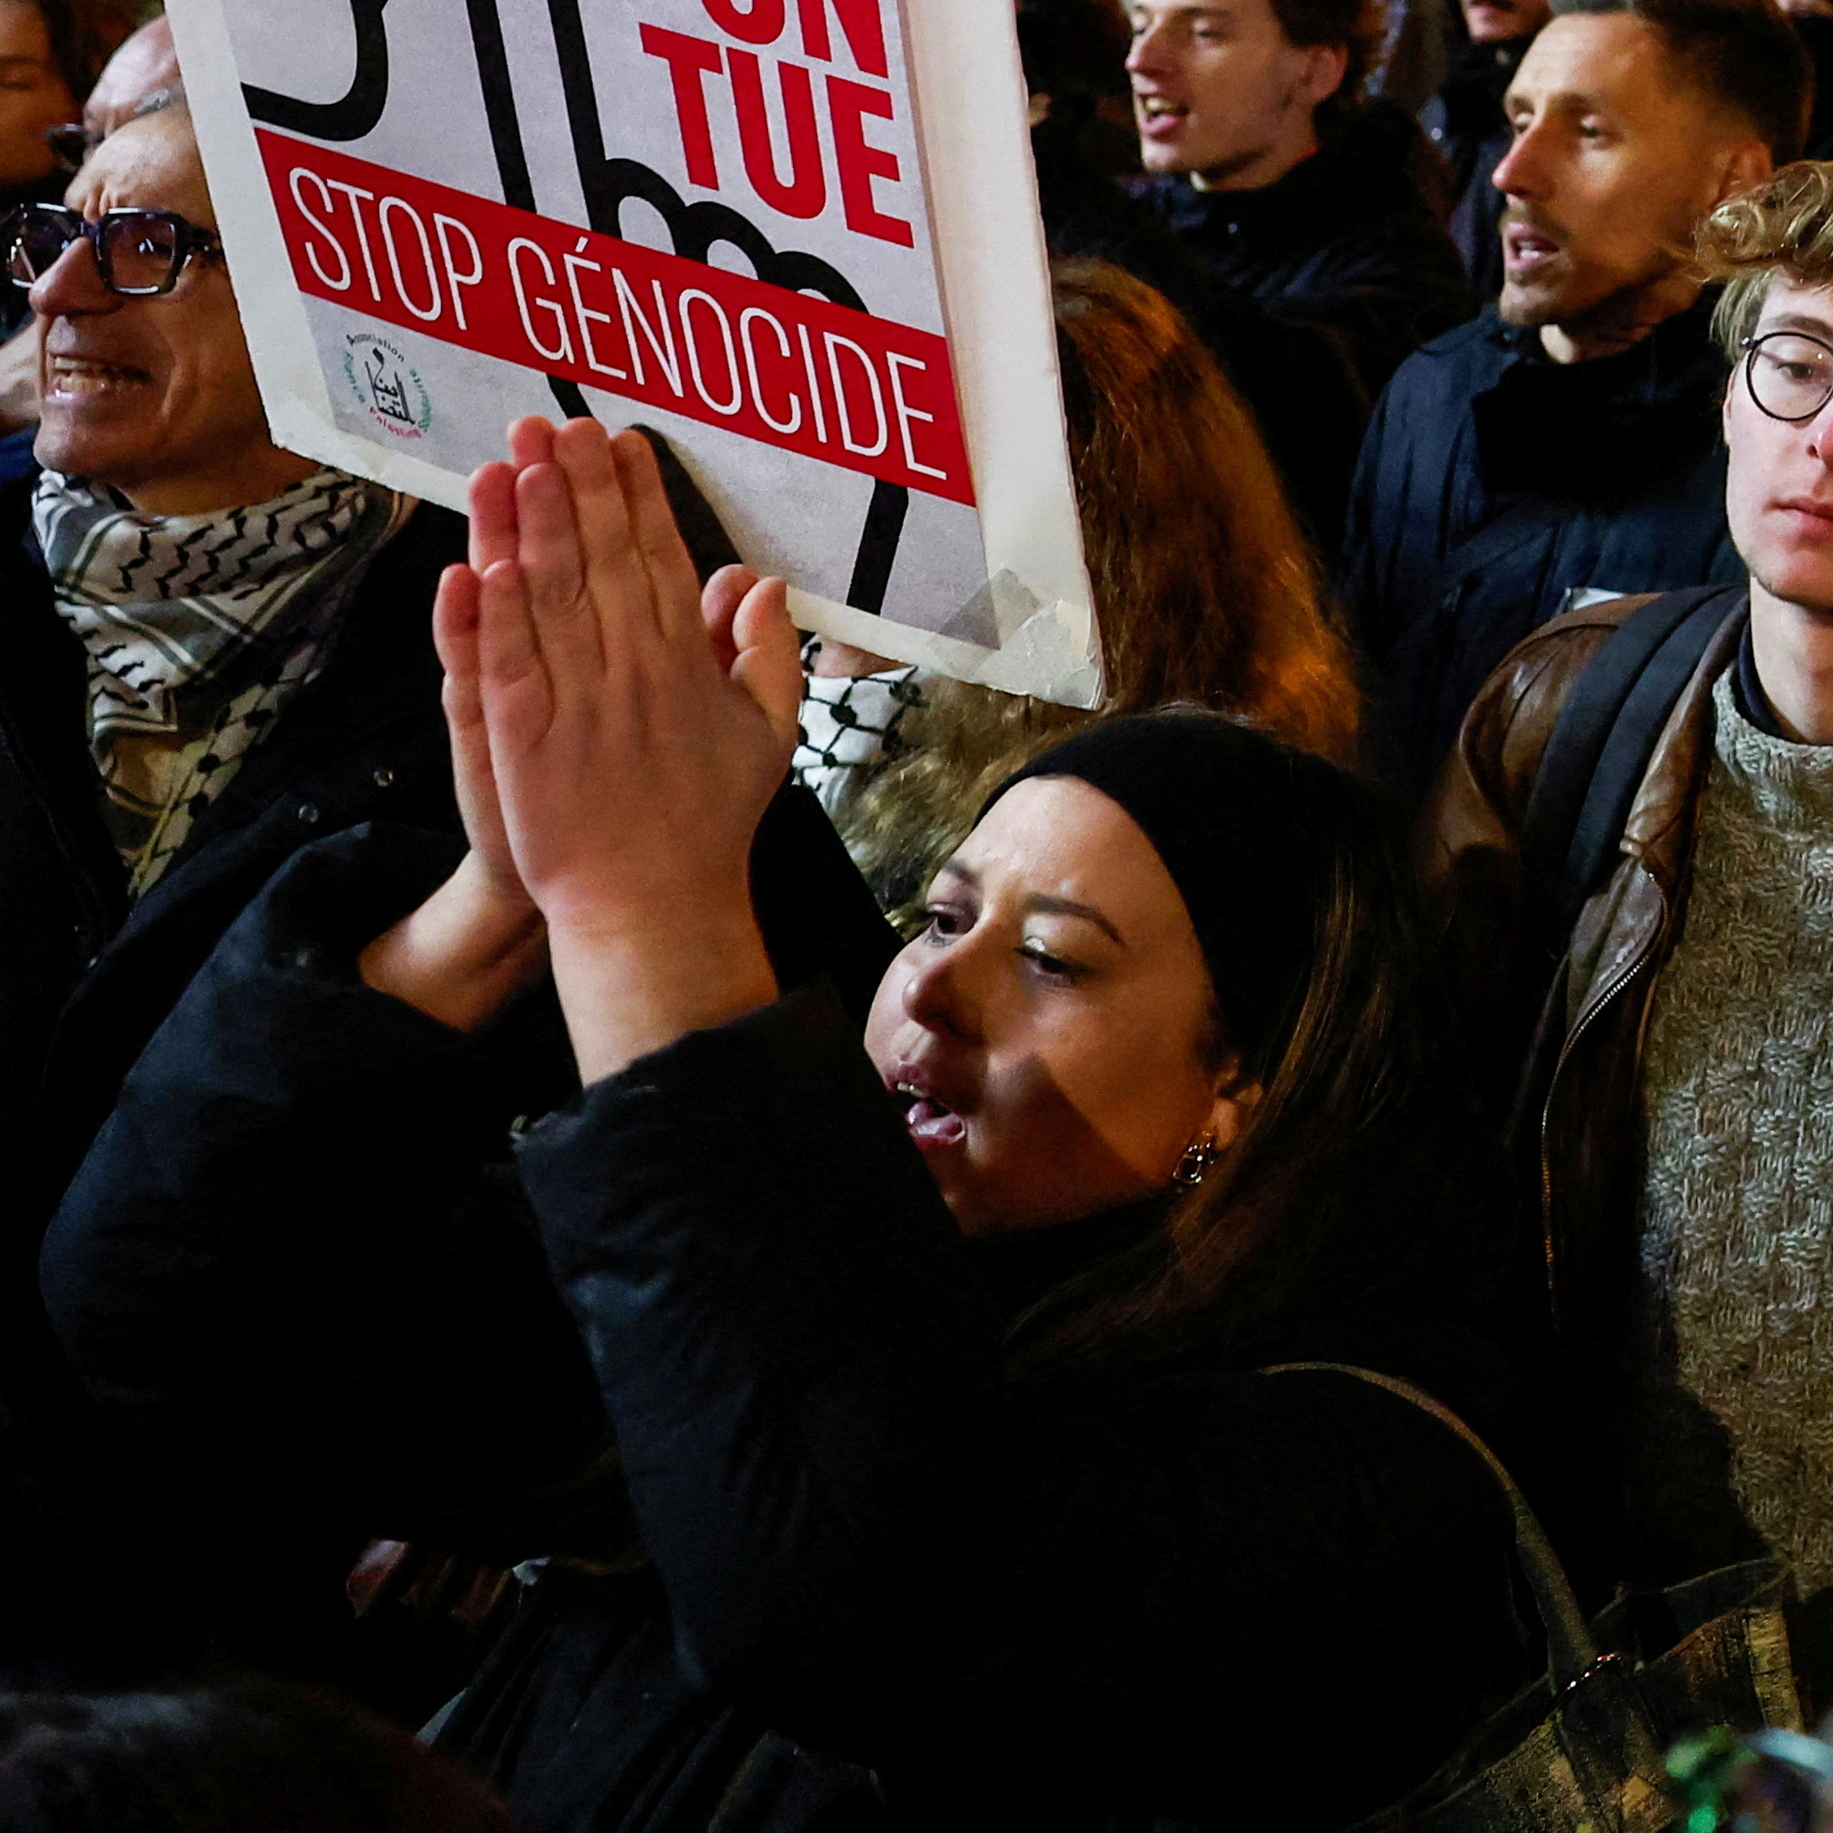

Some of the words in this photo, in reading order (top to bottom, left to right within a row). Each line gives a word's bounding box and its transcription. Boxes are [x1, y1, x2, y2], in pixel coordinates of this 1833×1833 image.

[638, 21, 915, 249] TUE
[288, 166, 483, 331] STOP
[506, 236, 948, 481] GÉNOCIDE
